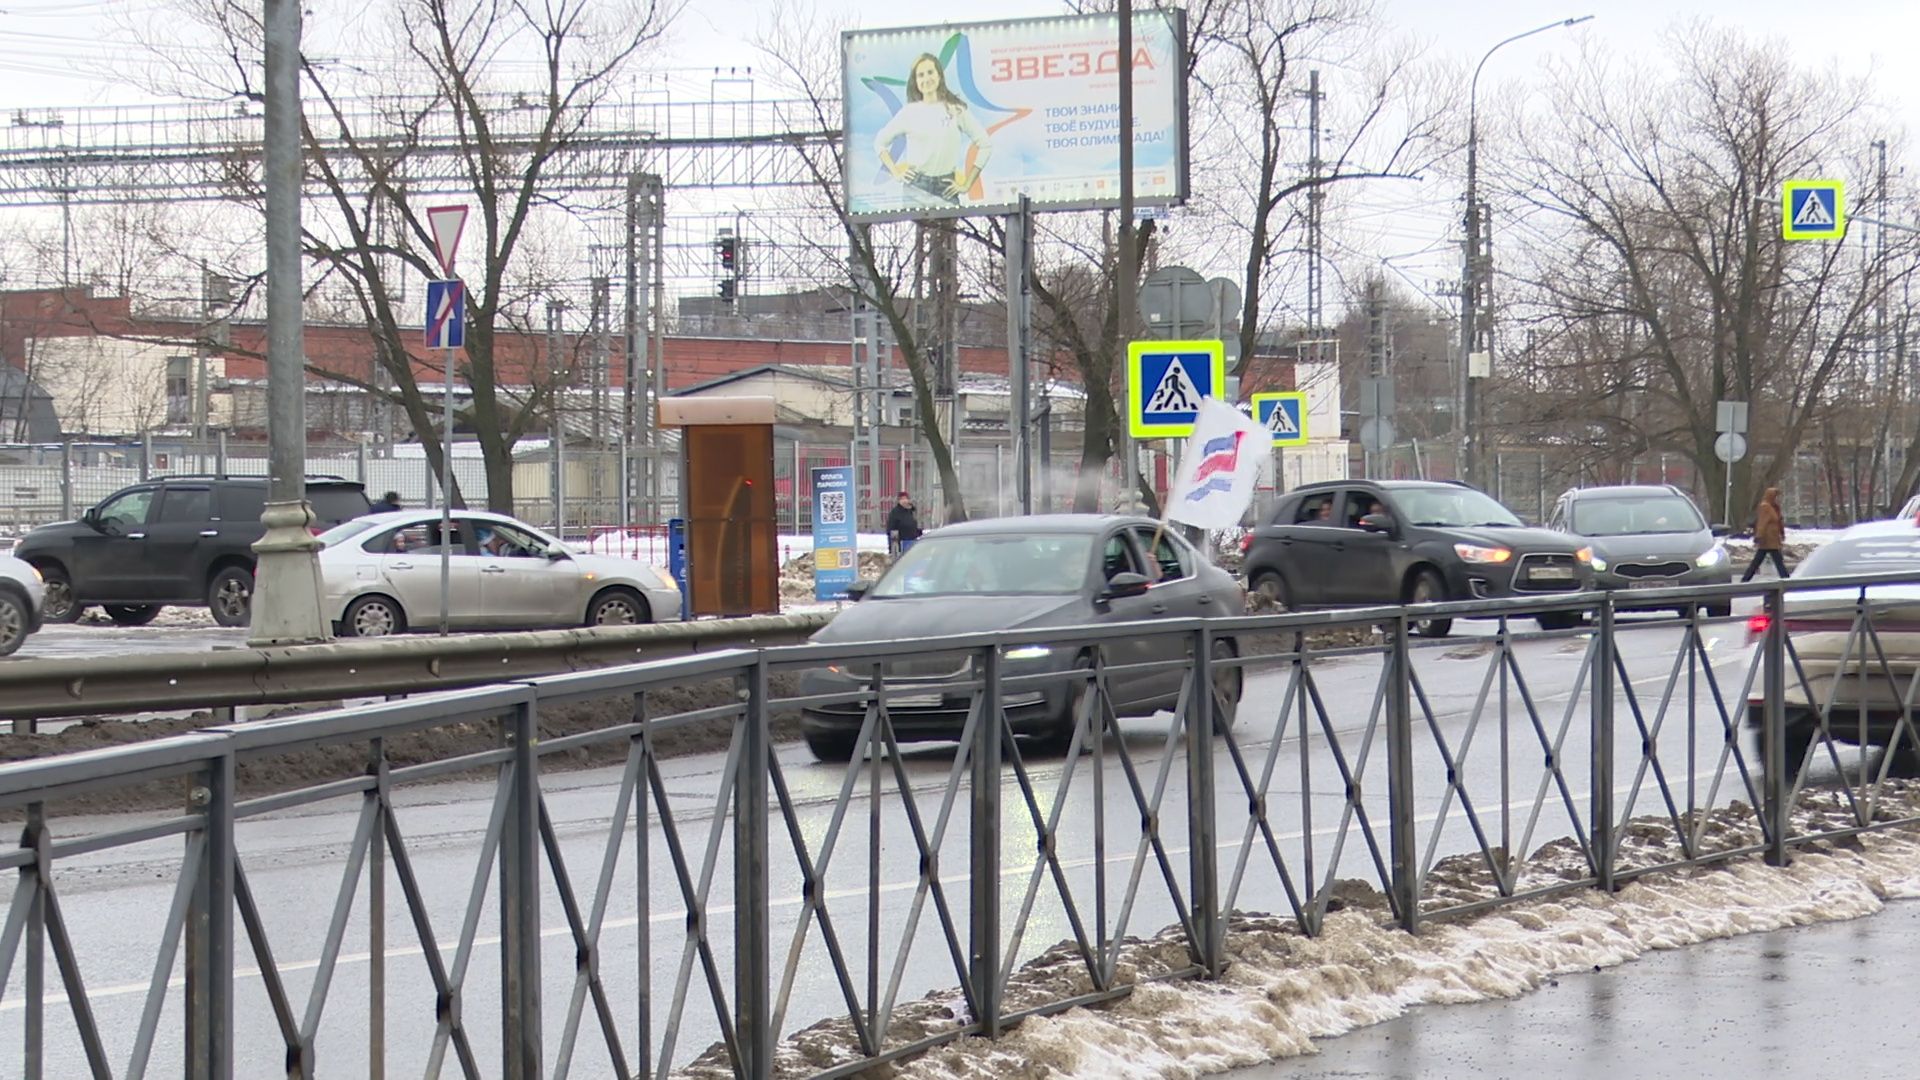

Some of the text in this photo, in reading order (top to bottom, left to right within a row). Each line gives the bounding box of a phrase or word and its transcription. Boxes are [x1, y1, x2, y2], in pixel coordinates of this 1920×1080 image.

[991, 47, 1154, 83] ЗВЕЗДА
[1045, 102, 1120, 118] ТВОИ ЗНАНИ
[1045, 120, 1077, 134] ТВОЁ
[1046, 129, 1165, 149] ТВОЯ ОЛИМАДА!
